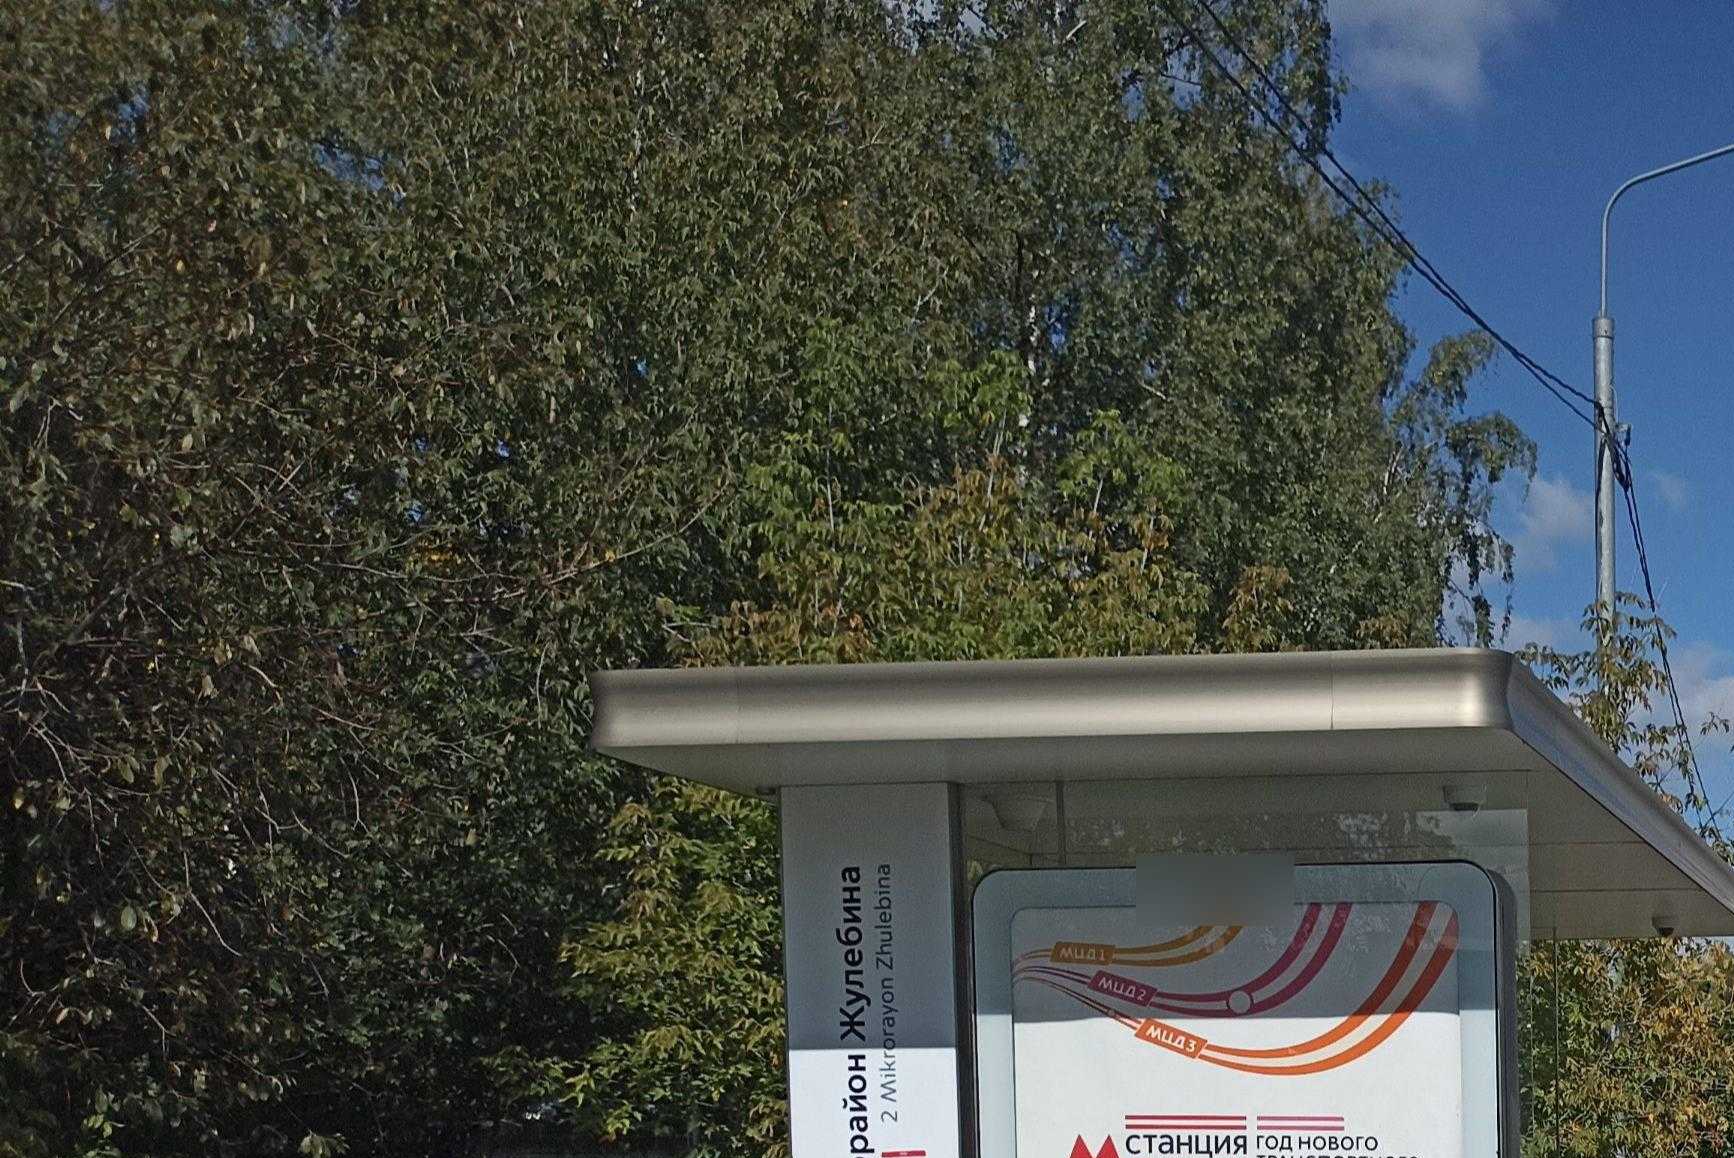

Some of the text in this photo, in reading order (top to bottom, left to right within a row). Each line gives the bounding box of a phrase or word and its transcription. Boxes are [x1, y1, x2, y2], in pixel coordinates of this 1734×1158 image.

[836, 866, 871, 1042] Жулебина
[874, 864, 898, 1123] 2 Mikrorayon Zhulebina
[1256, 1134, 1379, 1152] ГОД НОВОГО
